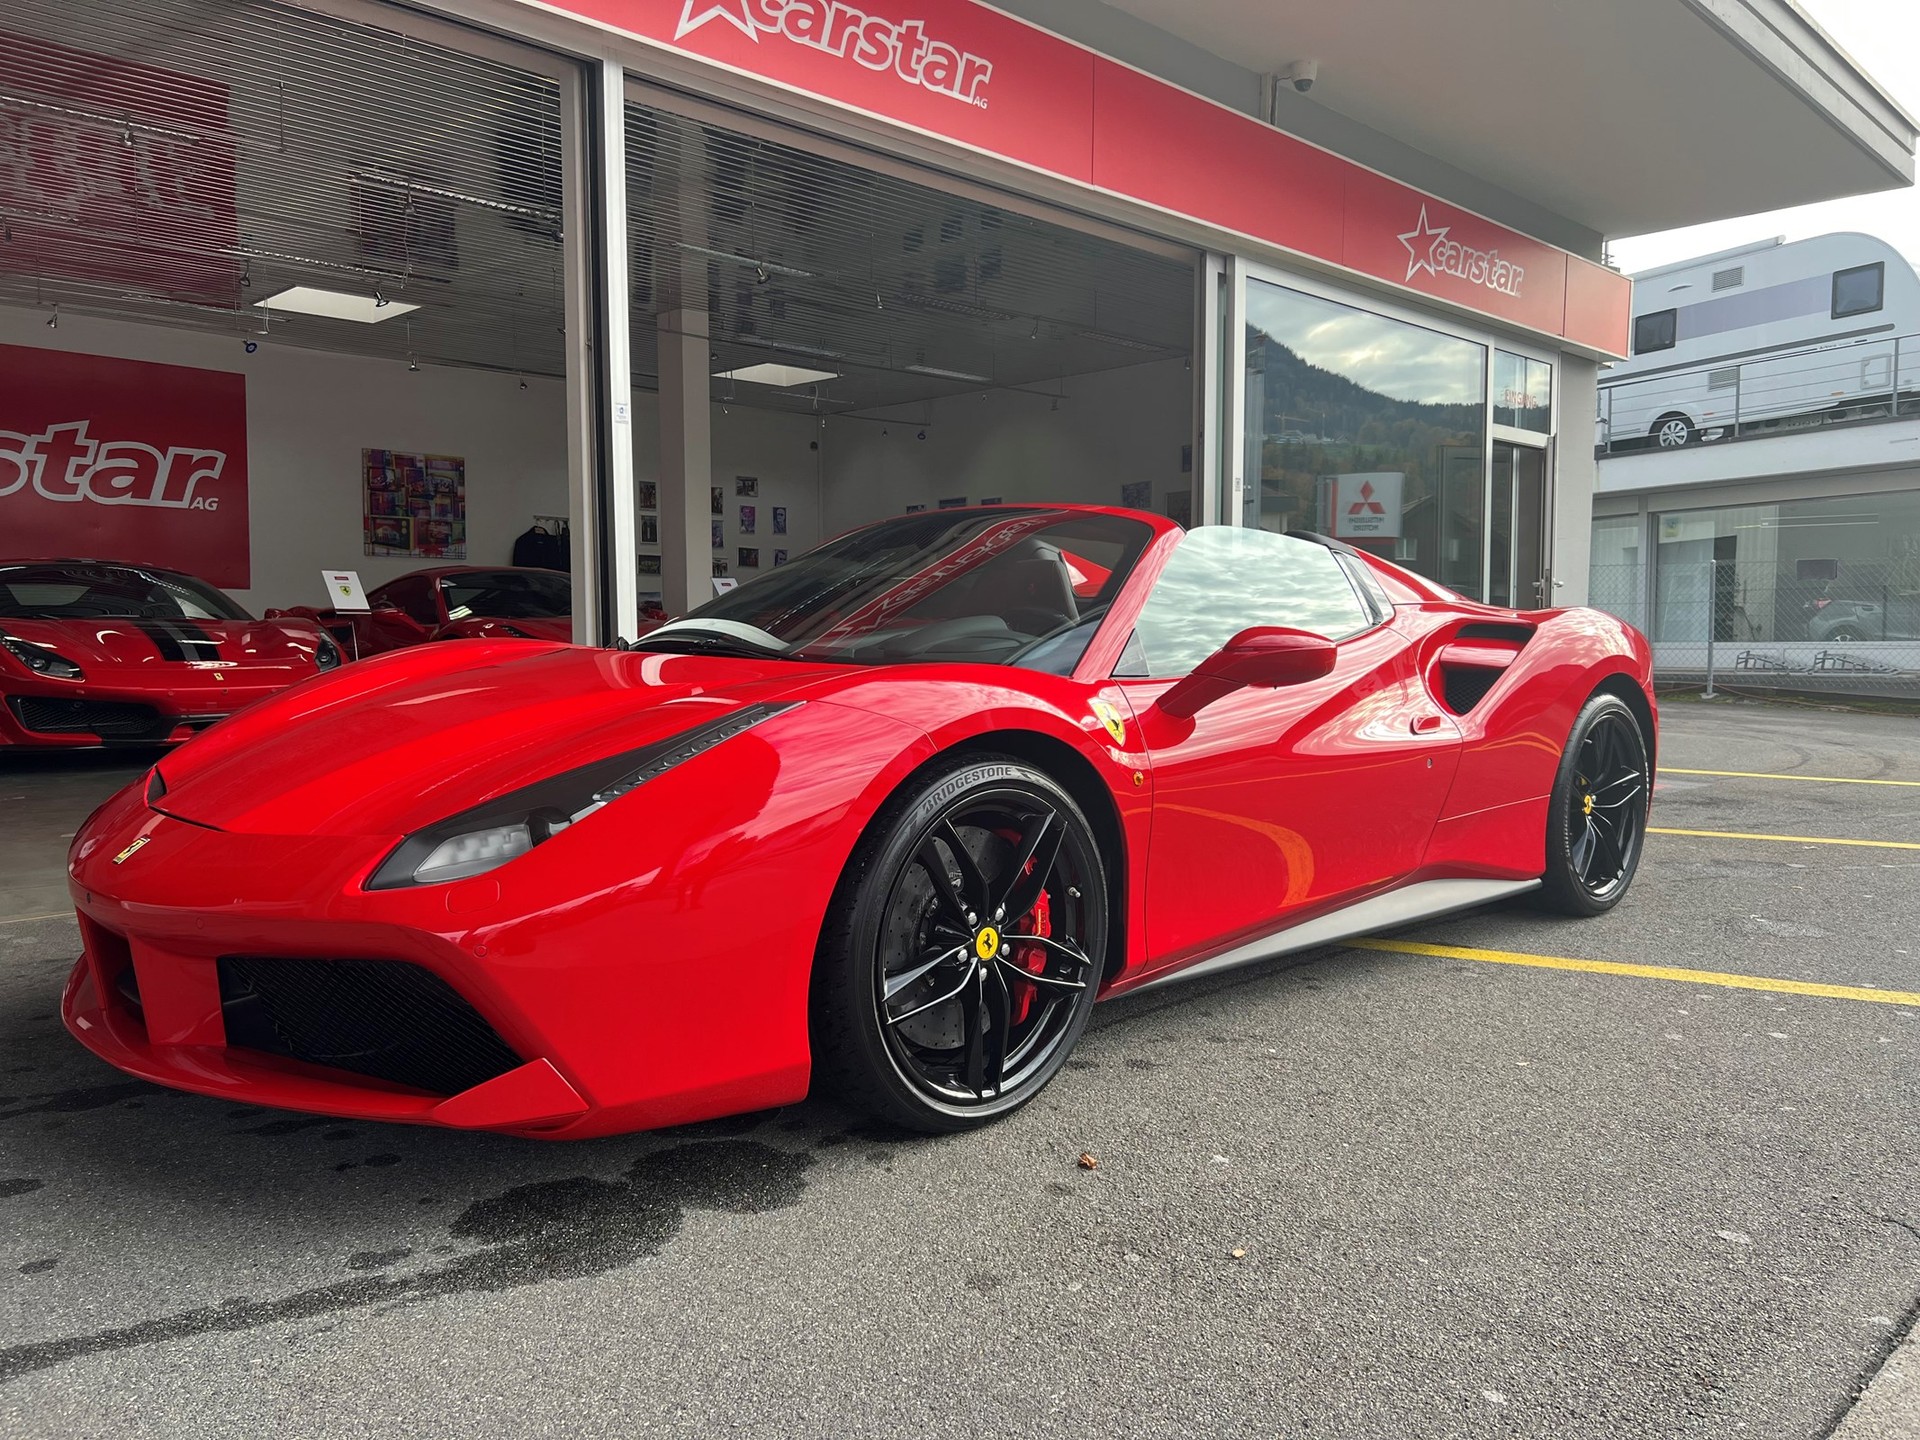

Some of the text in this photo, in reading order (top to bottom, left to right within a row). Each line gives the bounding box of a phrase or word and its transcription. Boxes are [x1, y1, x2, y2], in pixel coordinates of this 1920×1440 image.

[750, 0, 993, 109] carstar AG
[1430, 238, 1524, 295] carstar
[190, 497, 219, 511] AG
[922, 767, 1012, 814] BRIDGESTONE
